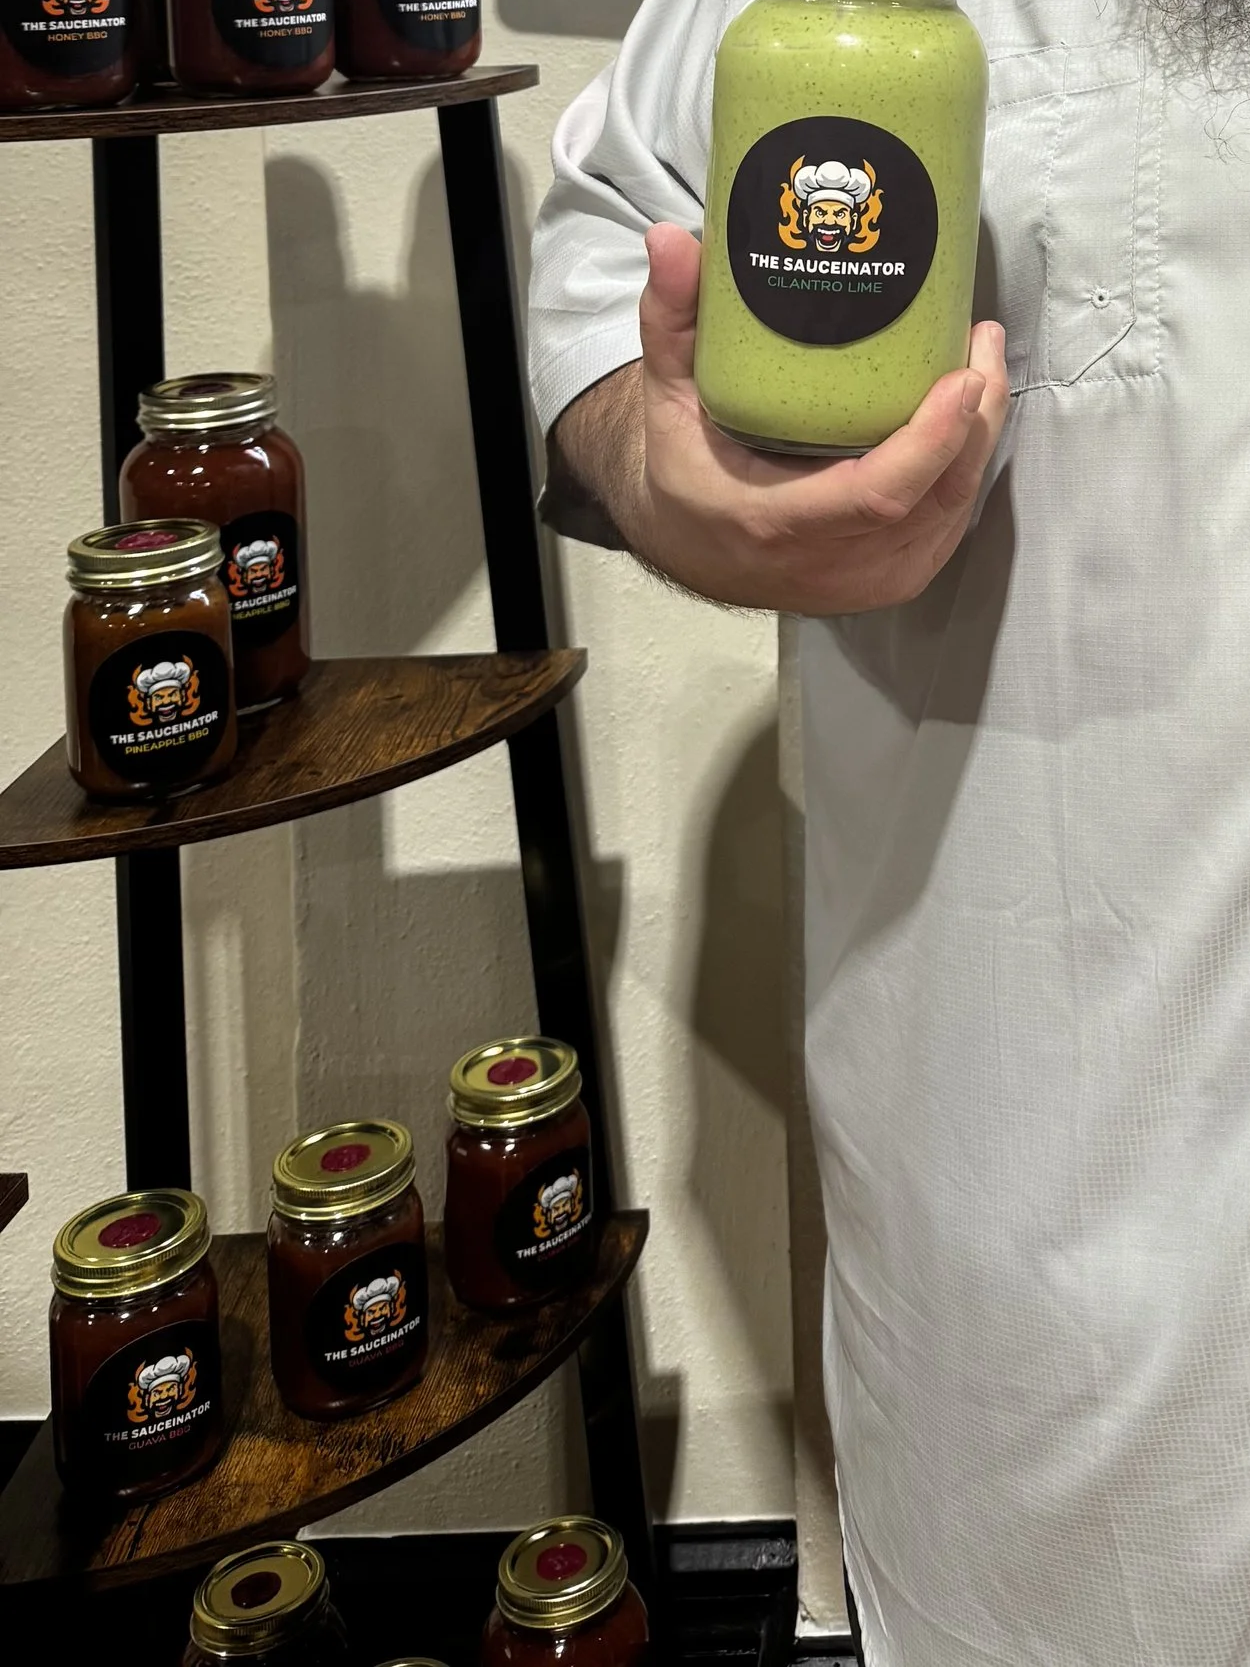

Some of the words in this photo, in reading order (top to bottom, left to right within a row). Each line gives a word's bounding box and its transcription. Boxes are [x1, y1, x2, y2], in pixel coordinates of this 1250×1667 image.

[398, 3, 420, 12] THE
[21, 22, 47, 31] THE
[49, 17, 126, 30] SAUCEINATOR
[234, 18, 259, 28] THE
[260, 13, 327, 26] SAUCEINATOR
[421, 13, 449, 21] HONEY
[47, 33, 84, 41] HONEY
[86, 31, 108, 40] BBQ
[260, 28, 293, 37] HONEY
[294, 26, 313, 35] BBQ
[749, 253, 780, 270] THE
[783, 257, 905, 276] SAUCEINATOR
[767, 276, 843, 292] CILANTRO
[848, 282, 883, 293] LIME
[234, 585, 297, 611] SAUCEINATOR
[233, 605, 272, 620] NEAPPLE
[110, 734, 135, 744] THE
[137, 710, 218, 742] SAUCEINATOR
[125, 735, 185, 754] PINEAPPLE
[188, 728, 209, 742] BBQ
[516, 1245, 538, 1259] THE
[324, 1350, 348, 1362] THE
[350, 1316, 420, 1357] SAUCEINATOR
[104, 1431, 129, 1442] THE
[131, 1400, 211, 1439] SAUCEINATOR
[128, 1434, 166, 1451] GUAVA
